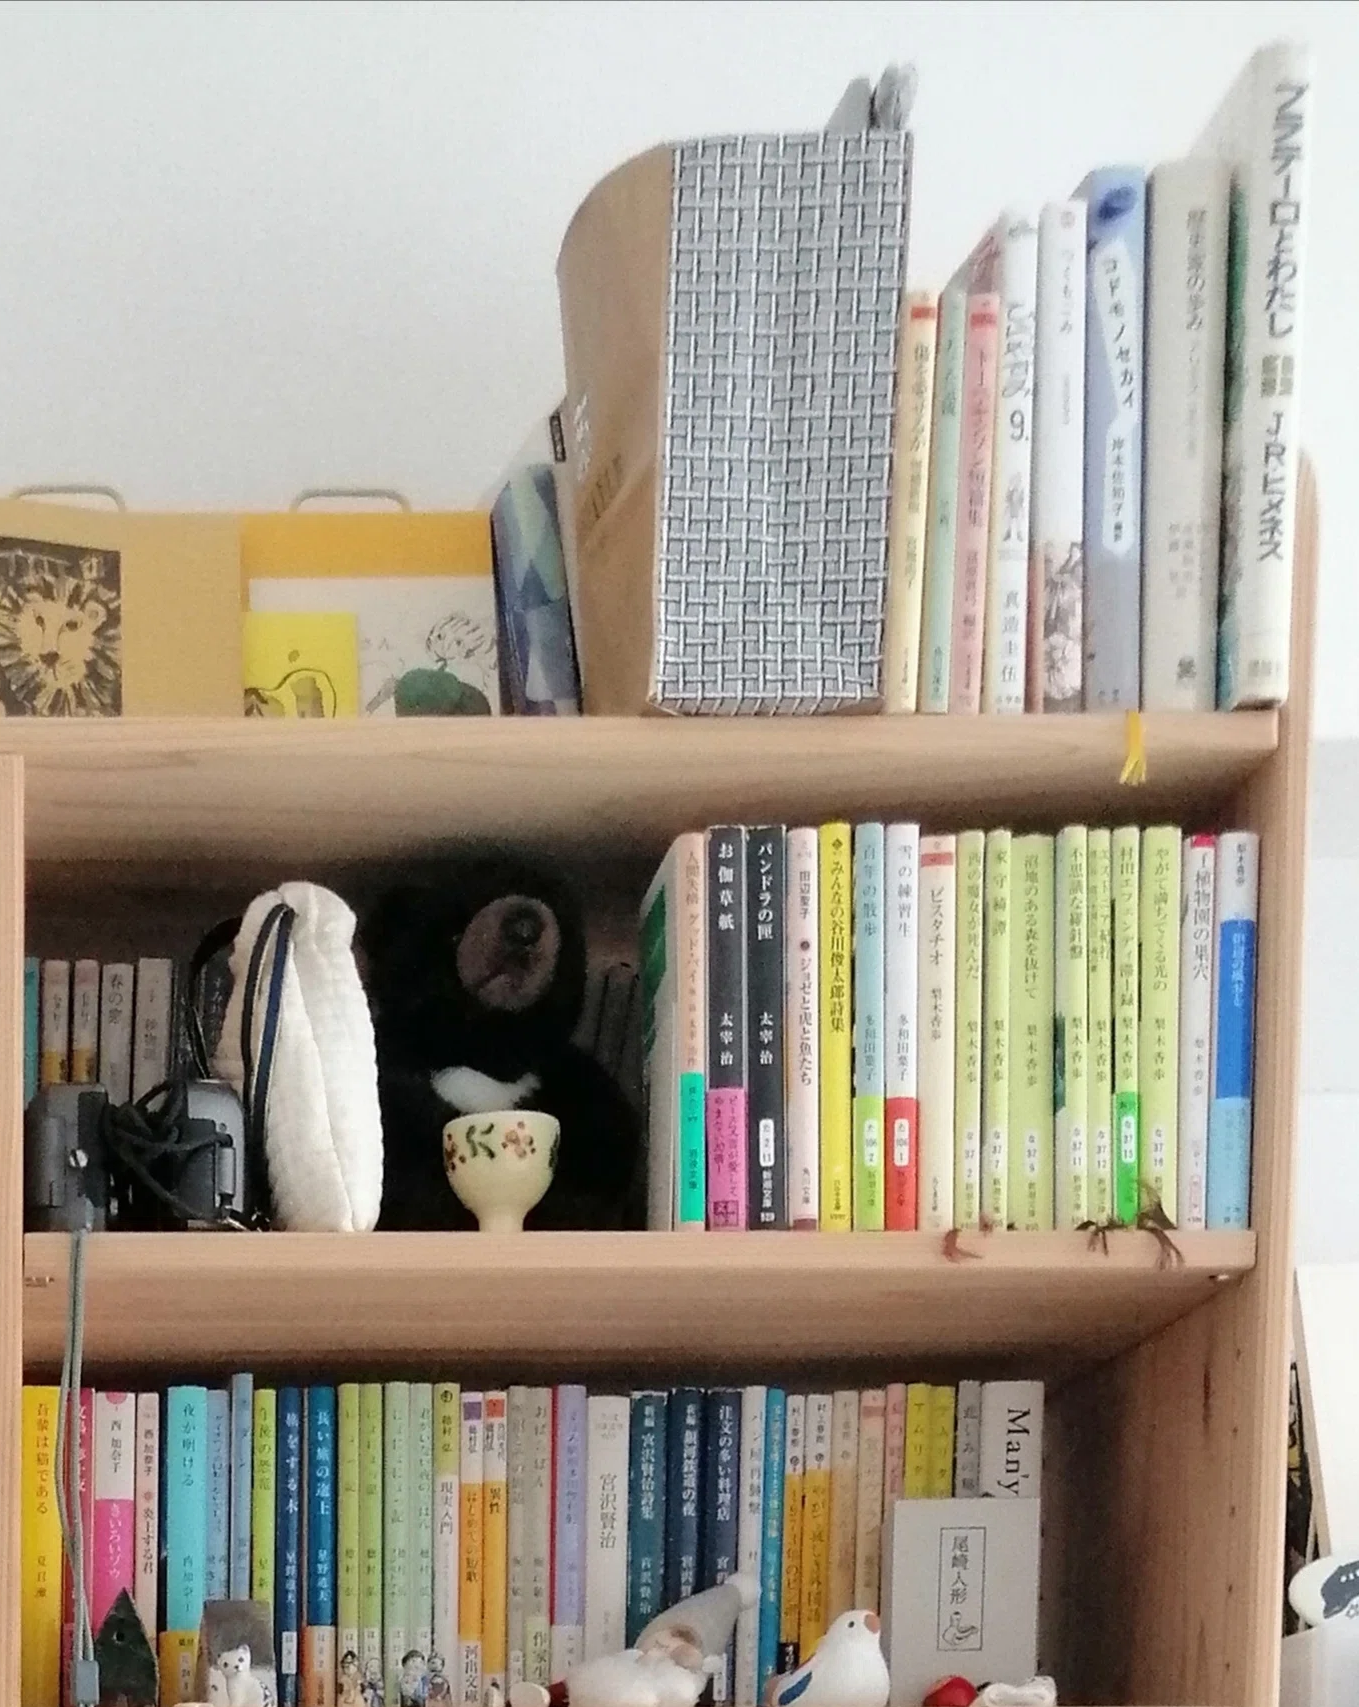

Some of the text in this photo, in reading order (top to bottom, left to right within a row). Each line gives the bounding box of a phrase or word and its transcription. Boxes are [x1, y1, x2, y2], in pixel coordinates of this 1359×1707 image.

[1100, 256, 1138, 410] コドモノセカイ
[897, 845, 913, 938] 雪の練習生
[929, 889, 945, 967] ピスタチオ
[718, 843, 735, 1067] お伽草紙 太宰治
[757, 843, 774, 1066] パンドラの匣 太宰治
[717, 1406, 732, 1521] 注文の多い料理店
[108, 1503, 121, 1579] きいろいゾウ
[598, 1473, 618, 1549] 宮沢賢治
[949, 1535, 969, 1606] 尾崎人形
[464, 1645, 478, 1702] 河出文庫
